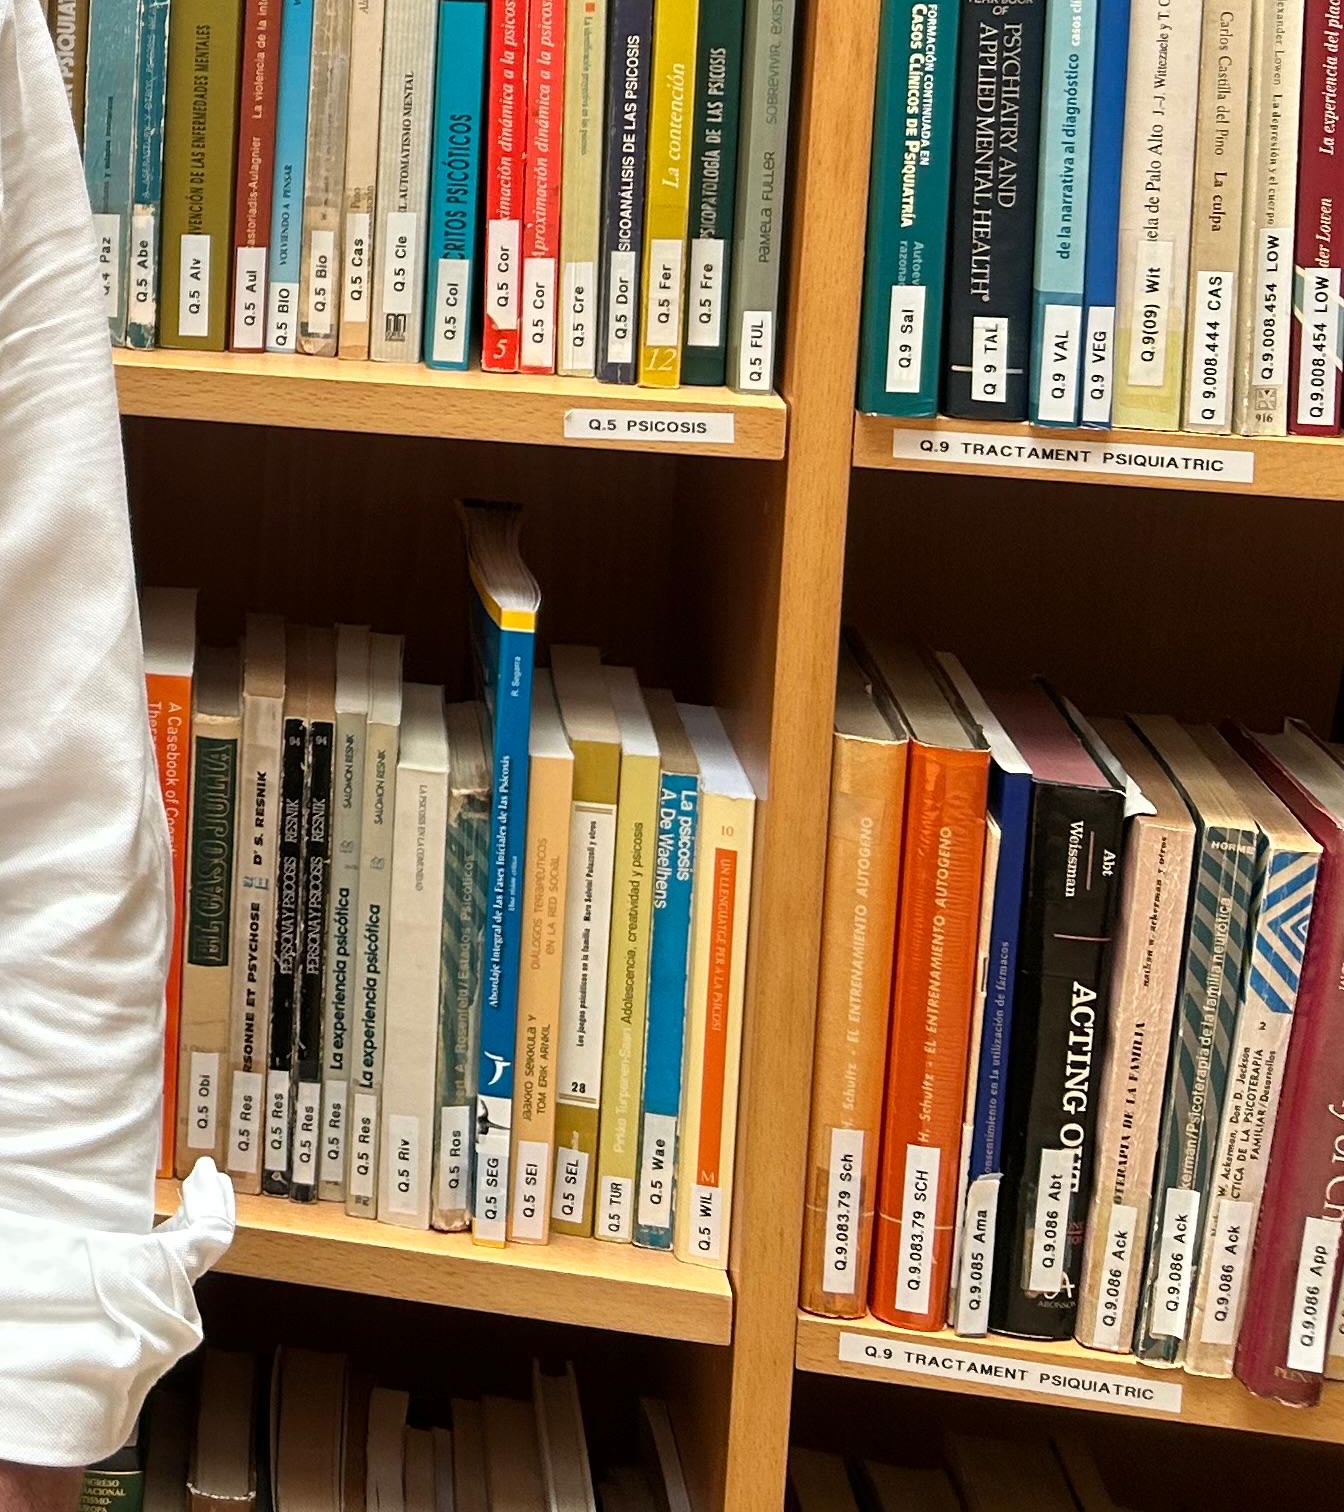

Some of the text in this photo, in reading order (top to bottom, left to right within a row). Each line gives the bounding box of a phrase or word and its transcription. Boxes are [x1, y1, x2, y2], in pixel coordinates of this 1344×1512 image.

[195, 24, 211, 73] MENTALES
[977, 22, 999, 113] APPLIED
[191, 74, 209, 148] ENFERMEDADES
[661, 62, 685, 189] La contención
[997, 23, 1023, 208] PSYCHIATRY AND
[1208, 11, 1234, 232] Carlos Castilla del Pino La culpa
[189, 171, 204, 184] DE
[191, 151, 206, 169] LAS
[449, 113, 472, 204] PSICÓTICOS
[973, 116, 996, 206] MENTAL
[1056, 53, 1081, 259] de la narrativa al diagnóstico
[749, 320, 763, 382] Q.5 FUL
[1091, 330, 1108, 399] Q.9 VEG
[589, 418, 707, 434] Q.5 PSICOSIS
[919, 437, 1224, 471] Q.9 TRACTAMENT PSIQUIATRIC
[674, 789, 698, 881] La psicosis
[1064, 820, 1086, 898] Weissman
[1102, 849, 1118, 877] Abt
[1061, 981, 1099, 1119] ACTING
[697, 1191, 714, 1250] Q.5 WIL
[864, 1345, 1155, 1402] Q.9 TRACTAMENT PSIQUIATRIC
